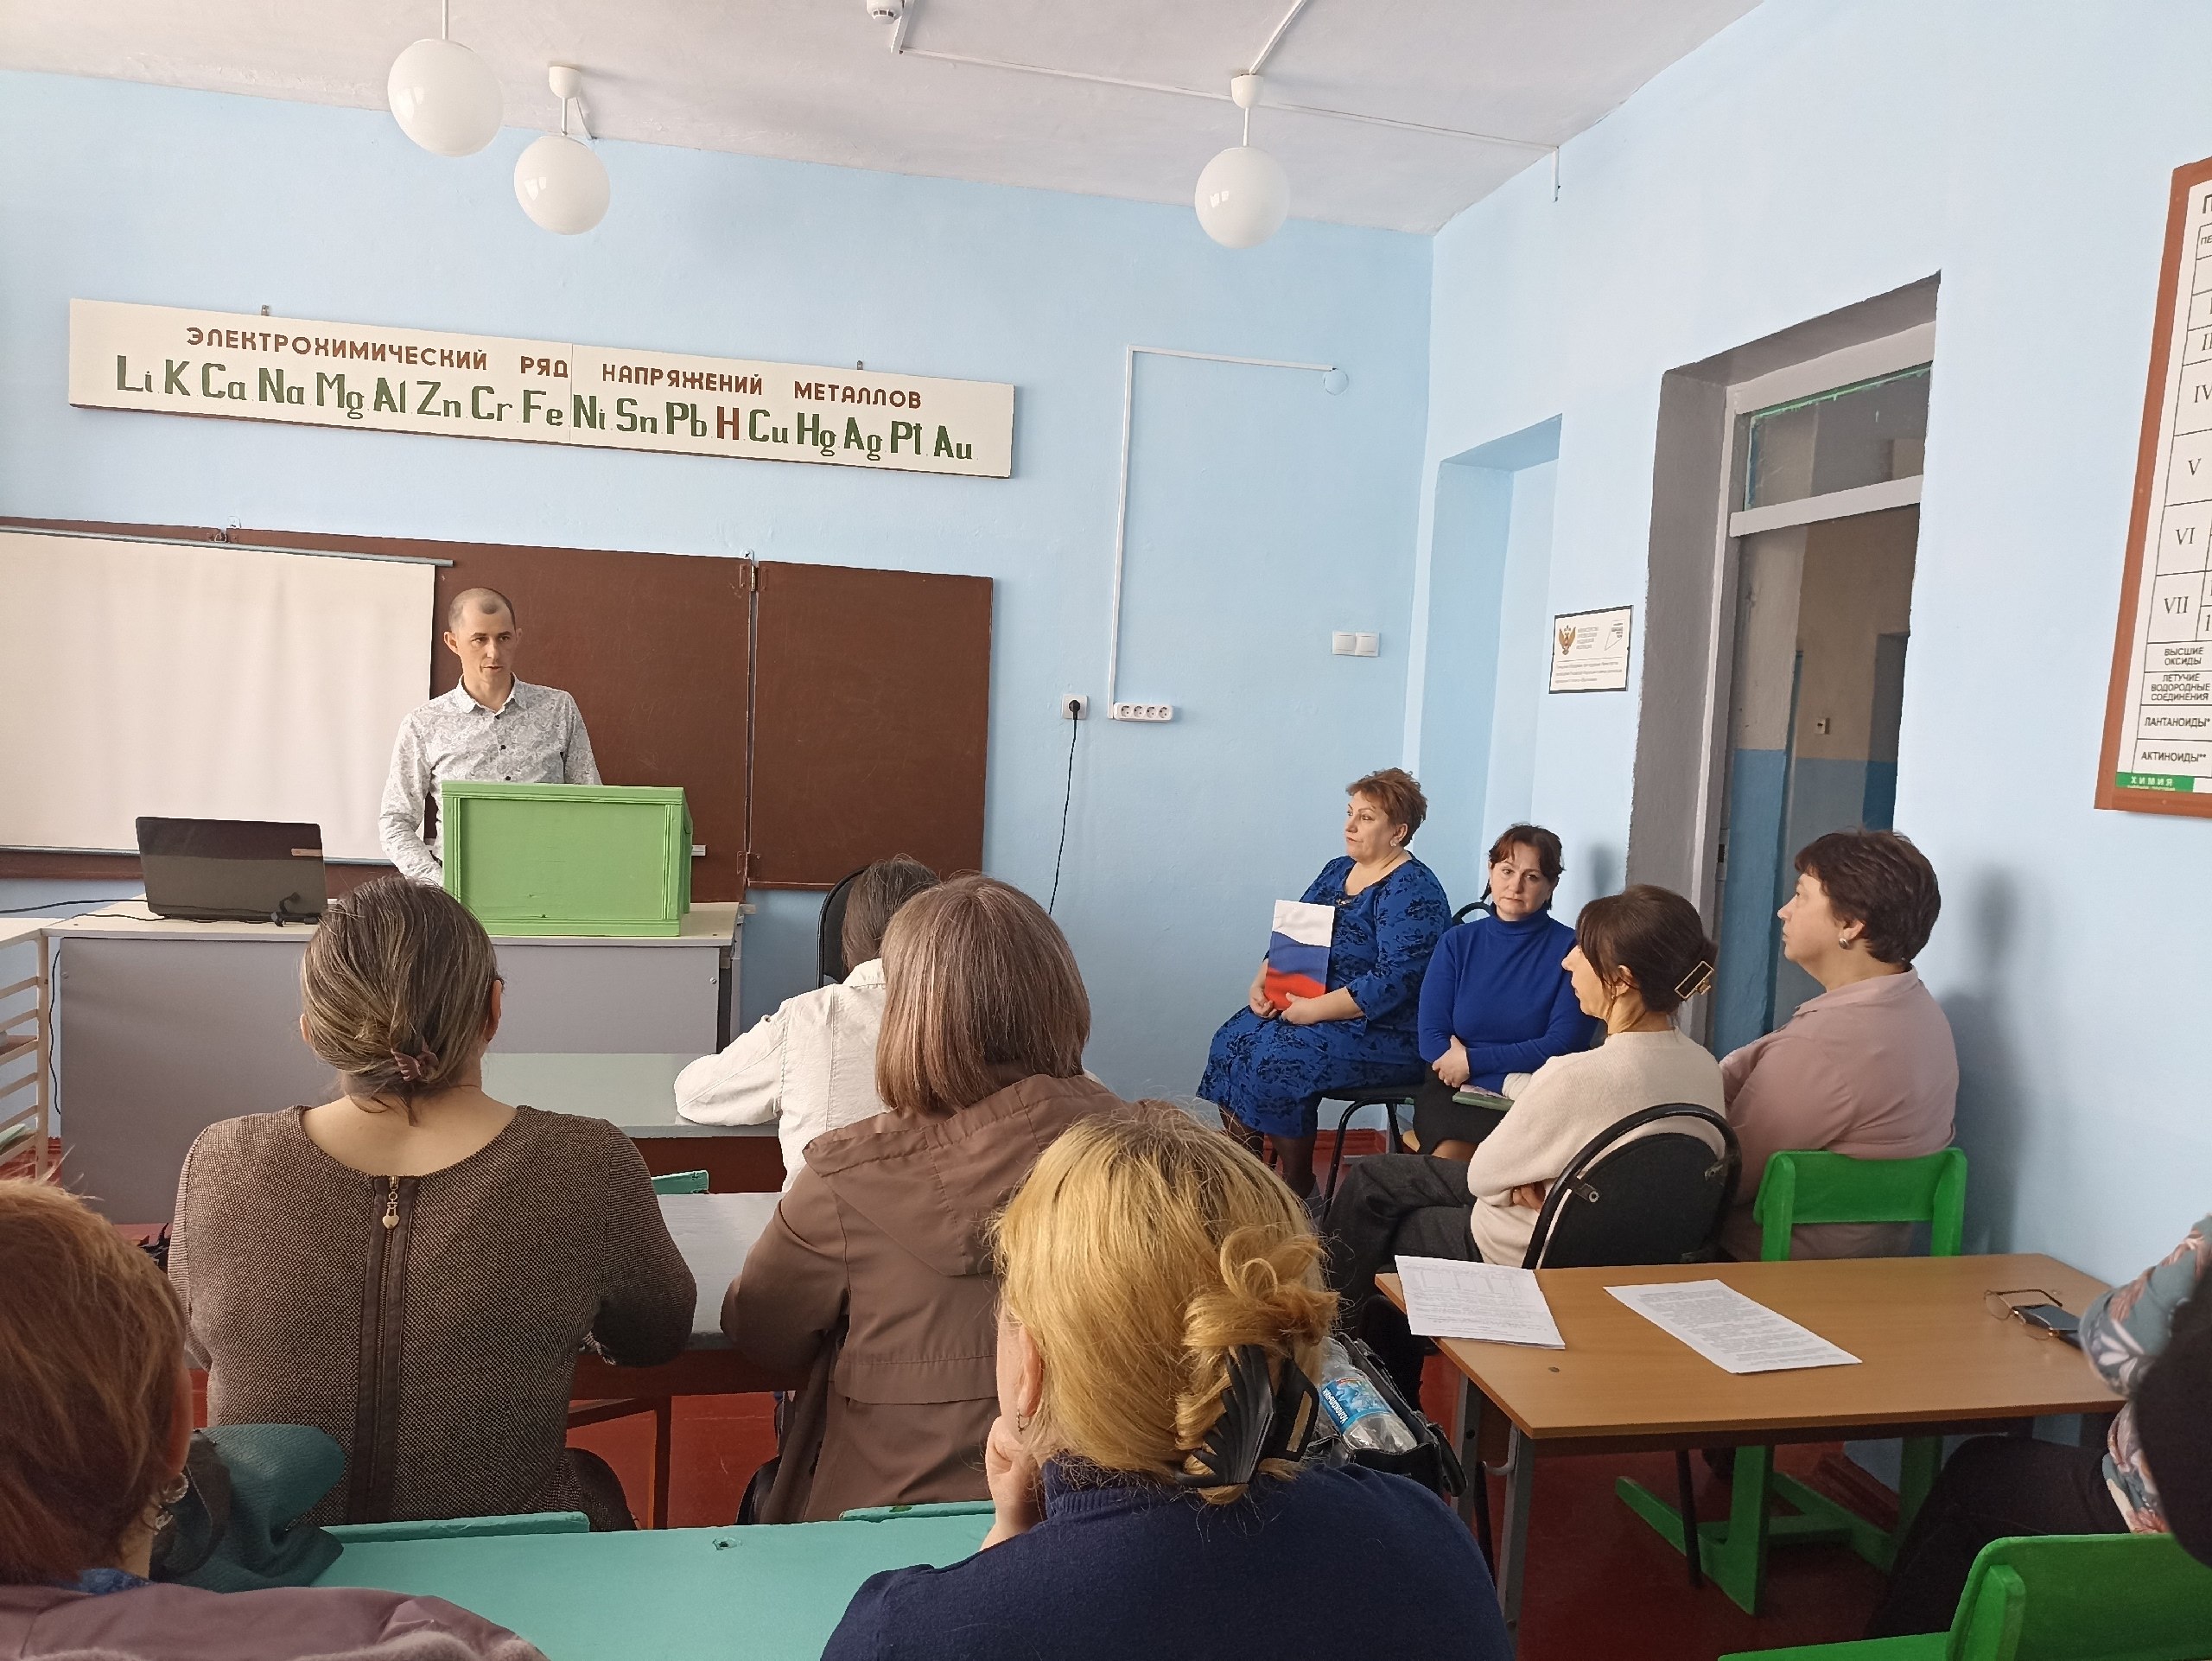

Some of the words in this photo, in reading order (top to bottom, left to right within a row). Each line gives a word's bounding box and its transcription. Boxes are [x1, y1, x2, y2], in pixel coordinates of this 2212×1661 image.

[186, 327, 487, 370] ЭЛЕКТРОХИМИЧЕСКИЙ
[520, 355, 569, 379] РЯД
[602, 363, 763, 396] НАПРЯЖЕНИЙ
[794, 380, 922, 409] МЕТАЛЛОВ
[117, 355, 154, 393] Li
[164, 360, 191, 397] K
[201, 363, 247, 401] Ca
[258, 368, 305, 405] Na
[316, 372, 365, 420] Mg
[372, 378, 406, 414] Al
[416, 380, 461, 418] Zn
[471, 386, 513, 422] Cr
[522, 390, 564, 427] Fe
[573, 394, 606, 430] Ni
[616, 398, 658, 435] Sn
[665, 402, 708, 437] Pb
[716, 406, 740, 441] H
[748, 410, 789, 444] Cu
[797, 412, 837, 457] Hg
[843, 417, 883, 461] Ag
[933, 425, 973, 460] Au
[2188, 457, 2202, 476] V
[2175, 526, 2196, 545] VI
[2164, 595, 2189, 614] VII
[2164, 646, 2204, 656] ВЫСШИЕ
[2164, 657, 2202, 666] ОКСИДЫ
[2162, 673, 2202, 682] ЛЕТУЧИЕ
[2151, 683, 2211, 692] ВОДОРОДНЫЕ
[2151, 692, 2209, 702] СОЕДИНЕНИЯ
[2131, 775, 2173, 786] ХИМИЯ
